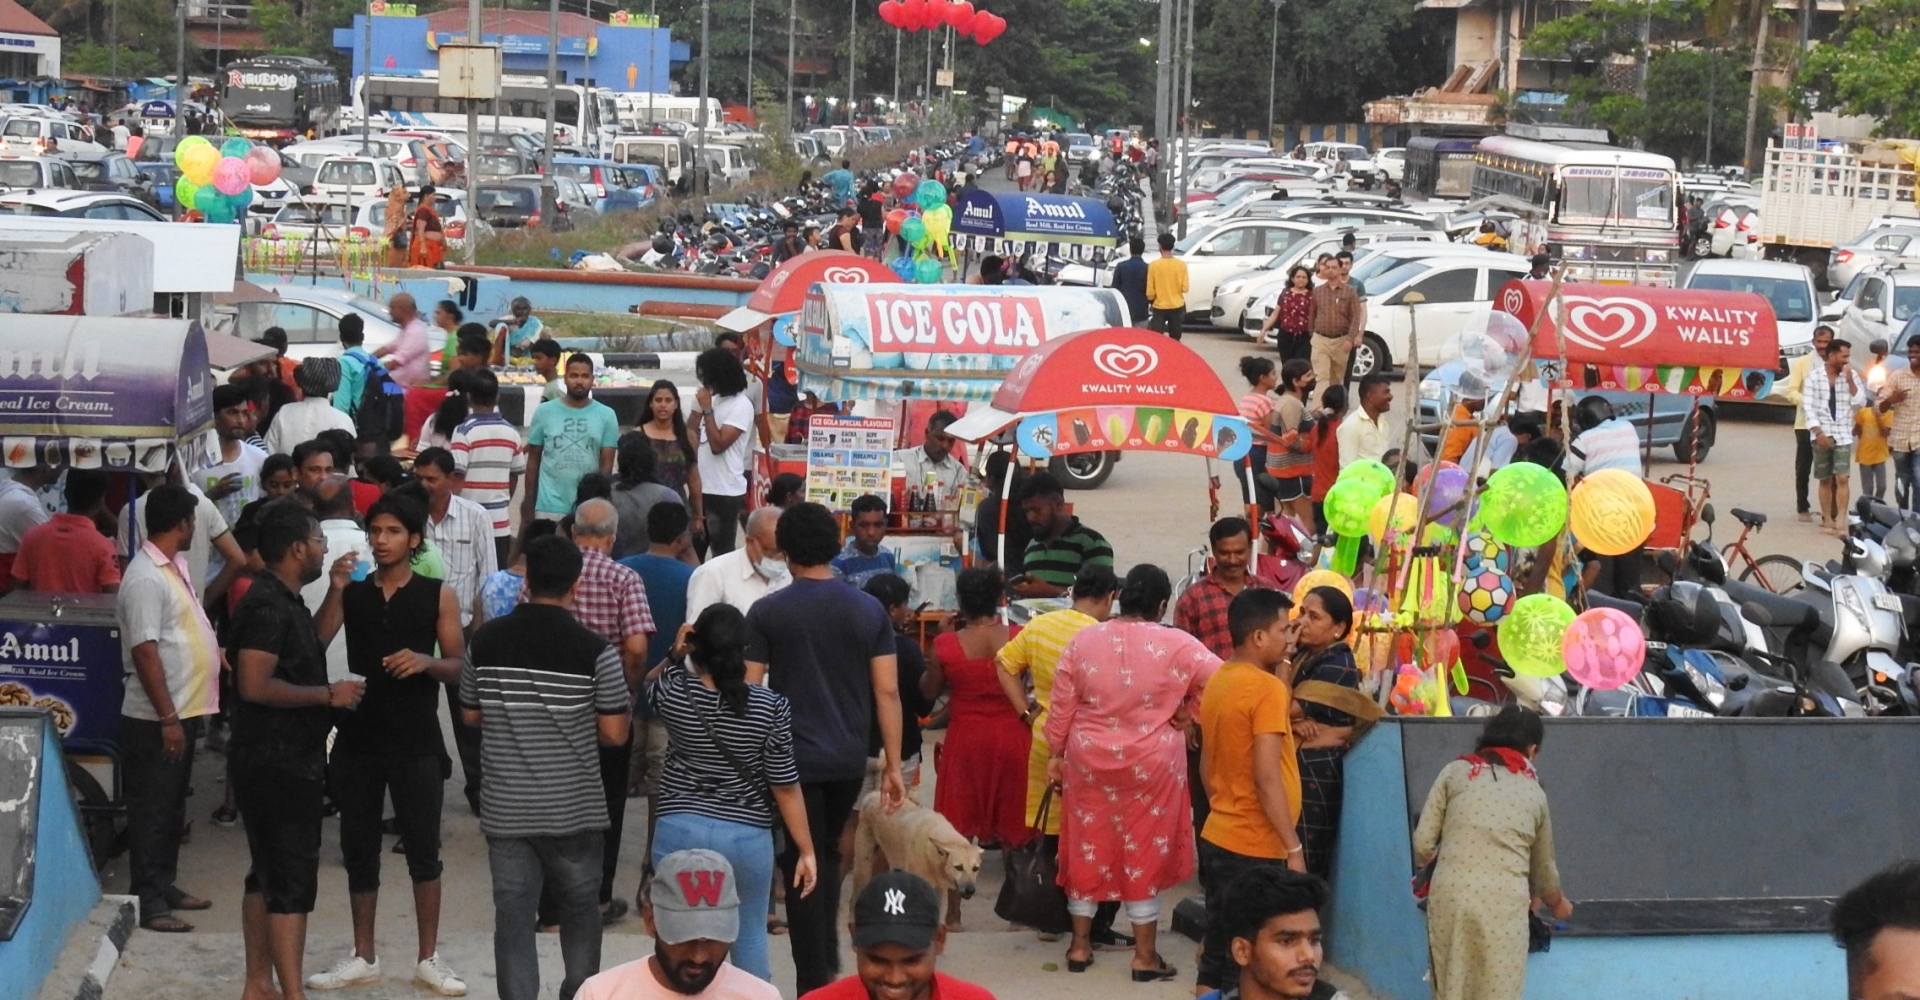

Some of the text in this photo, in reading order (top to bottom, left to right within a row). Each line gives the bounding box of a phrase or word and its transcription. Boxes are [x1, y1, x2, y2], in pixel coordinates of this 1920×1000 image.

[964, 200, 994, 219] Amul
[1025, 197, 1086, 219] Amul
[875, 299, 1040, 347] ICE GOLA
[1664, 305, 1758, 326] KWALITY
[1677, 325, 1751, 347] WALL'S
[1081, 383, 1175, 395] KWALITY WALL'S
[27, 396, 51, 410] Ice
[55, 396, 114, 412] Cream.
[563, 417, 588, 433] 25
[812, 418, 892, 429] ICE GOLA SPECIAL FLAVOURS
[0, 631, 80, 662] Amul
[28, 667, 46, 676] Real
[47, 668, 59, 677] Ice
[676, 870, 725, 907] W
